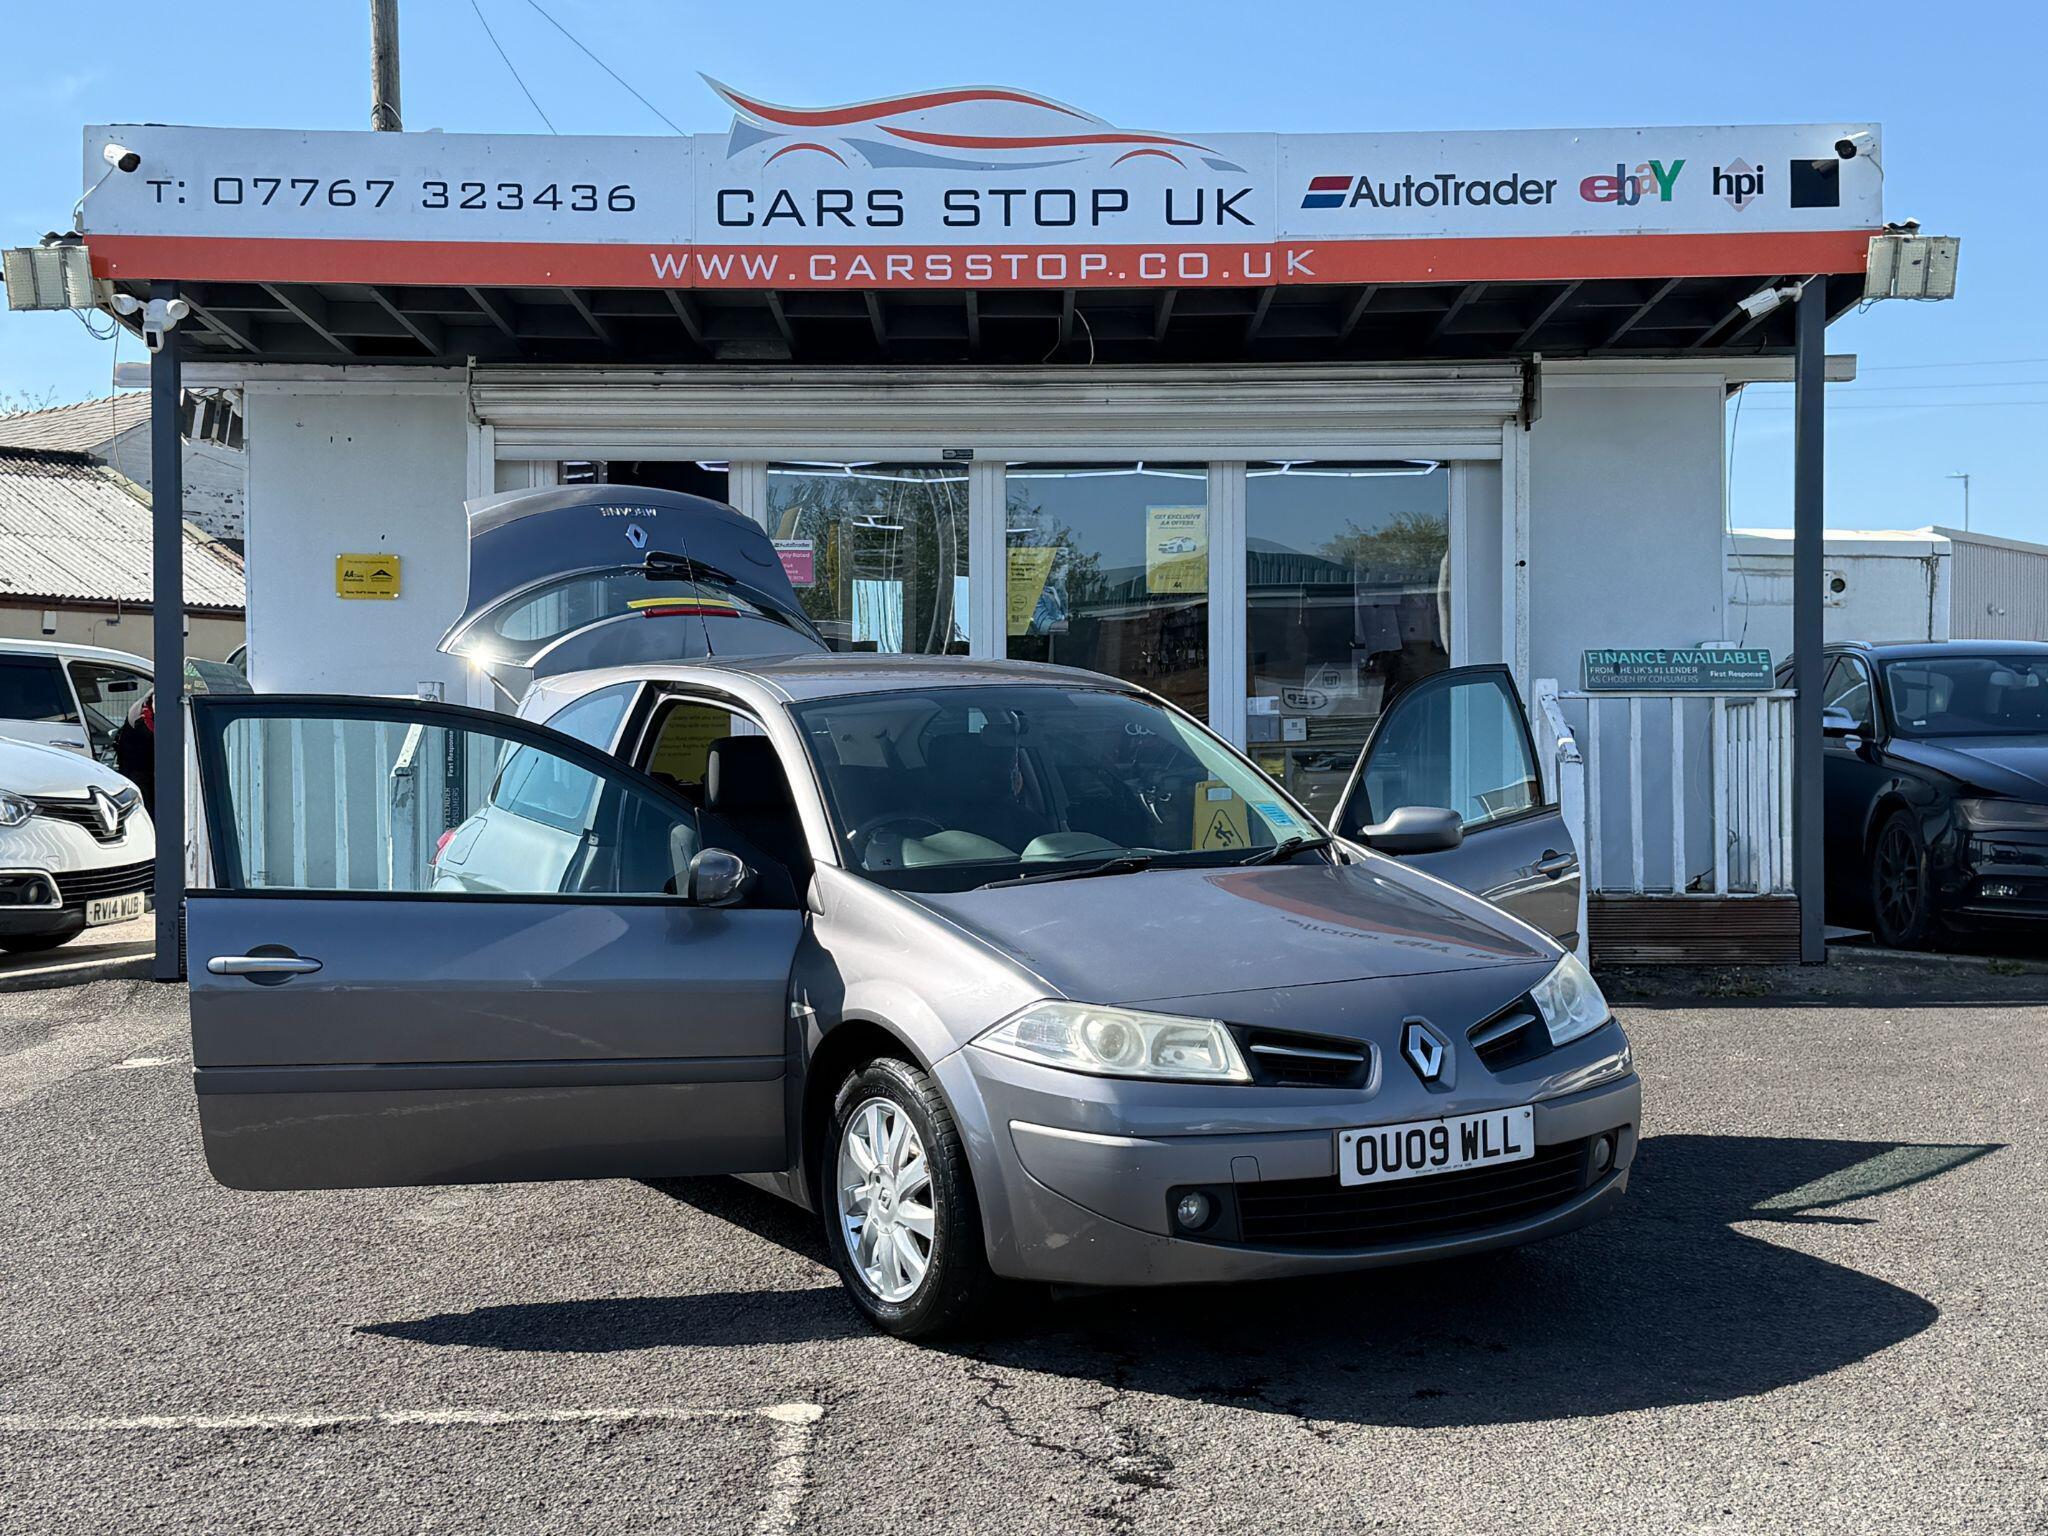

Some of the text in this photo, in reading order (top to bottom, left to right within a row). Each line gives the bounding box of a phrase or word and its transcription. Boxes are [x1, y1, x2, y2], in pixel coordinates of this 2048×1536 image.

[146, 177, 636, 212] T: 07767 323436
[1350, 172, 1558, 208] AutoTrader
[1713, 164, 1764, 204] hpi
[717, 187, 1256, 227] CARS STOP UK
[1588, 651, 1769, 664] FINANCE AVAILABLE
[1590, 666, 1614, 674] FROM
[1633, 666, 1653, 674] UK'S
[1665, 666, 1698, 674] LENDER
[94, 896, 139, 921] RV14 WUB
[1356, 1116, 1521, 1176] OU09 WLL
